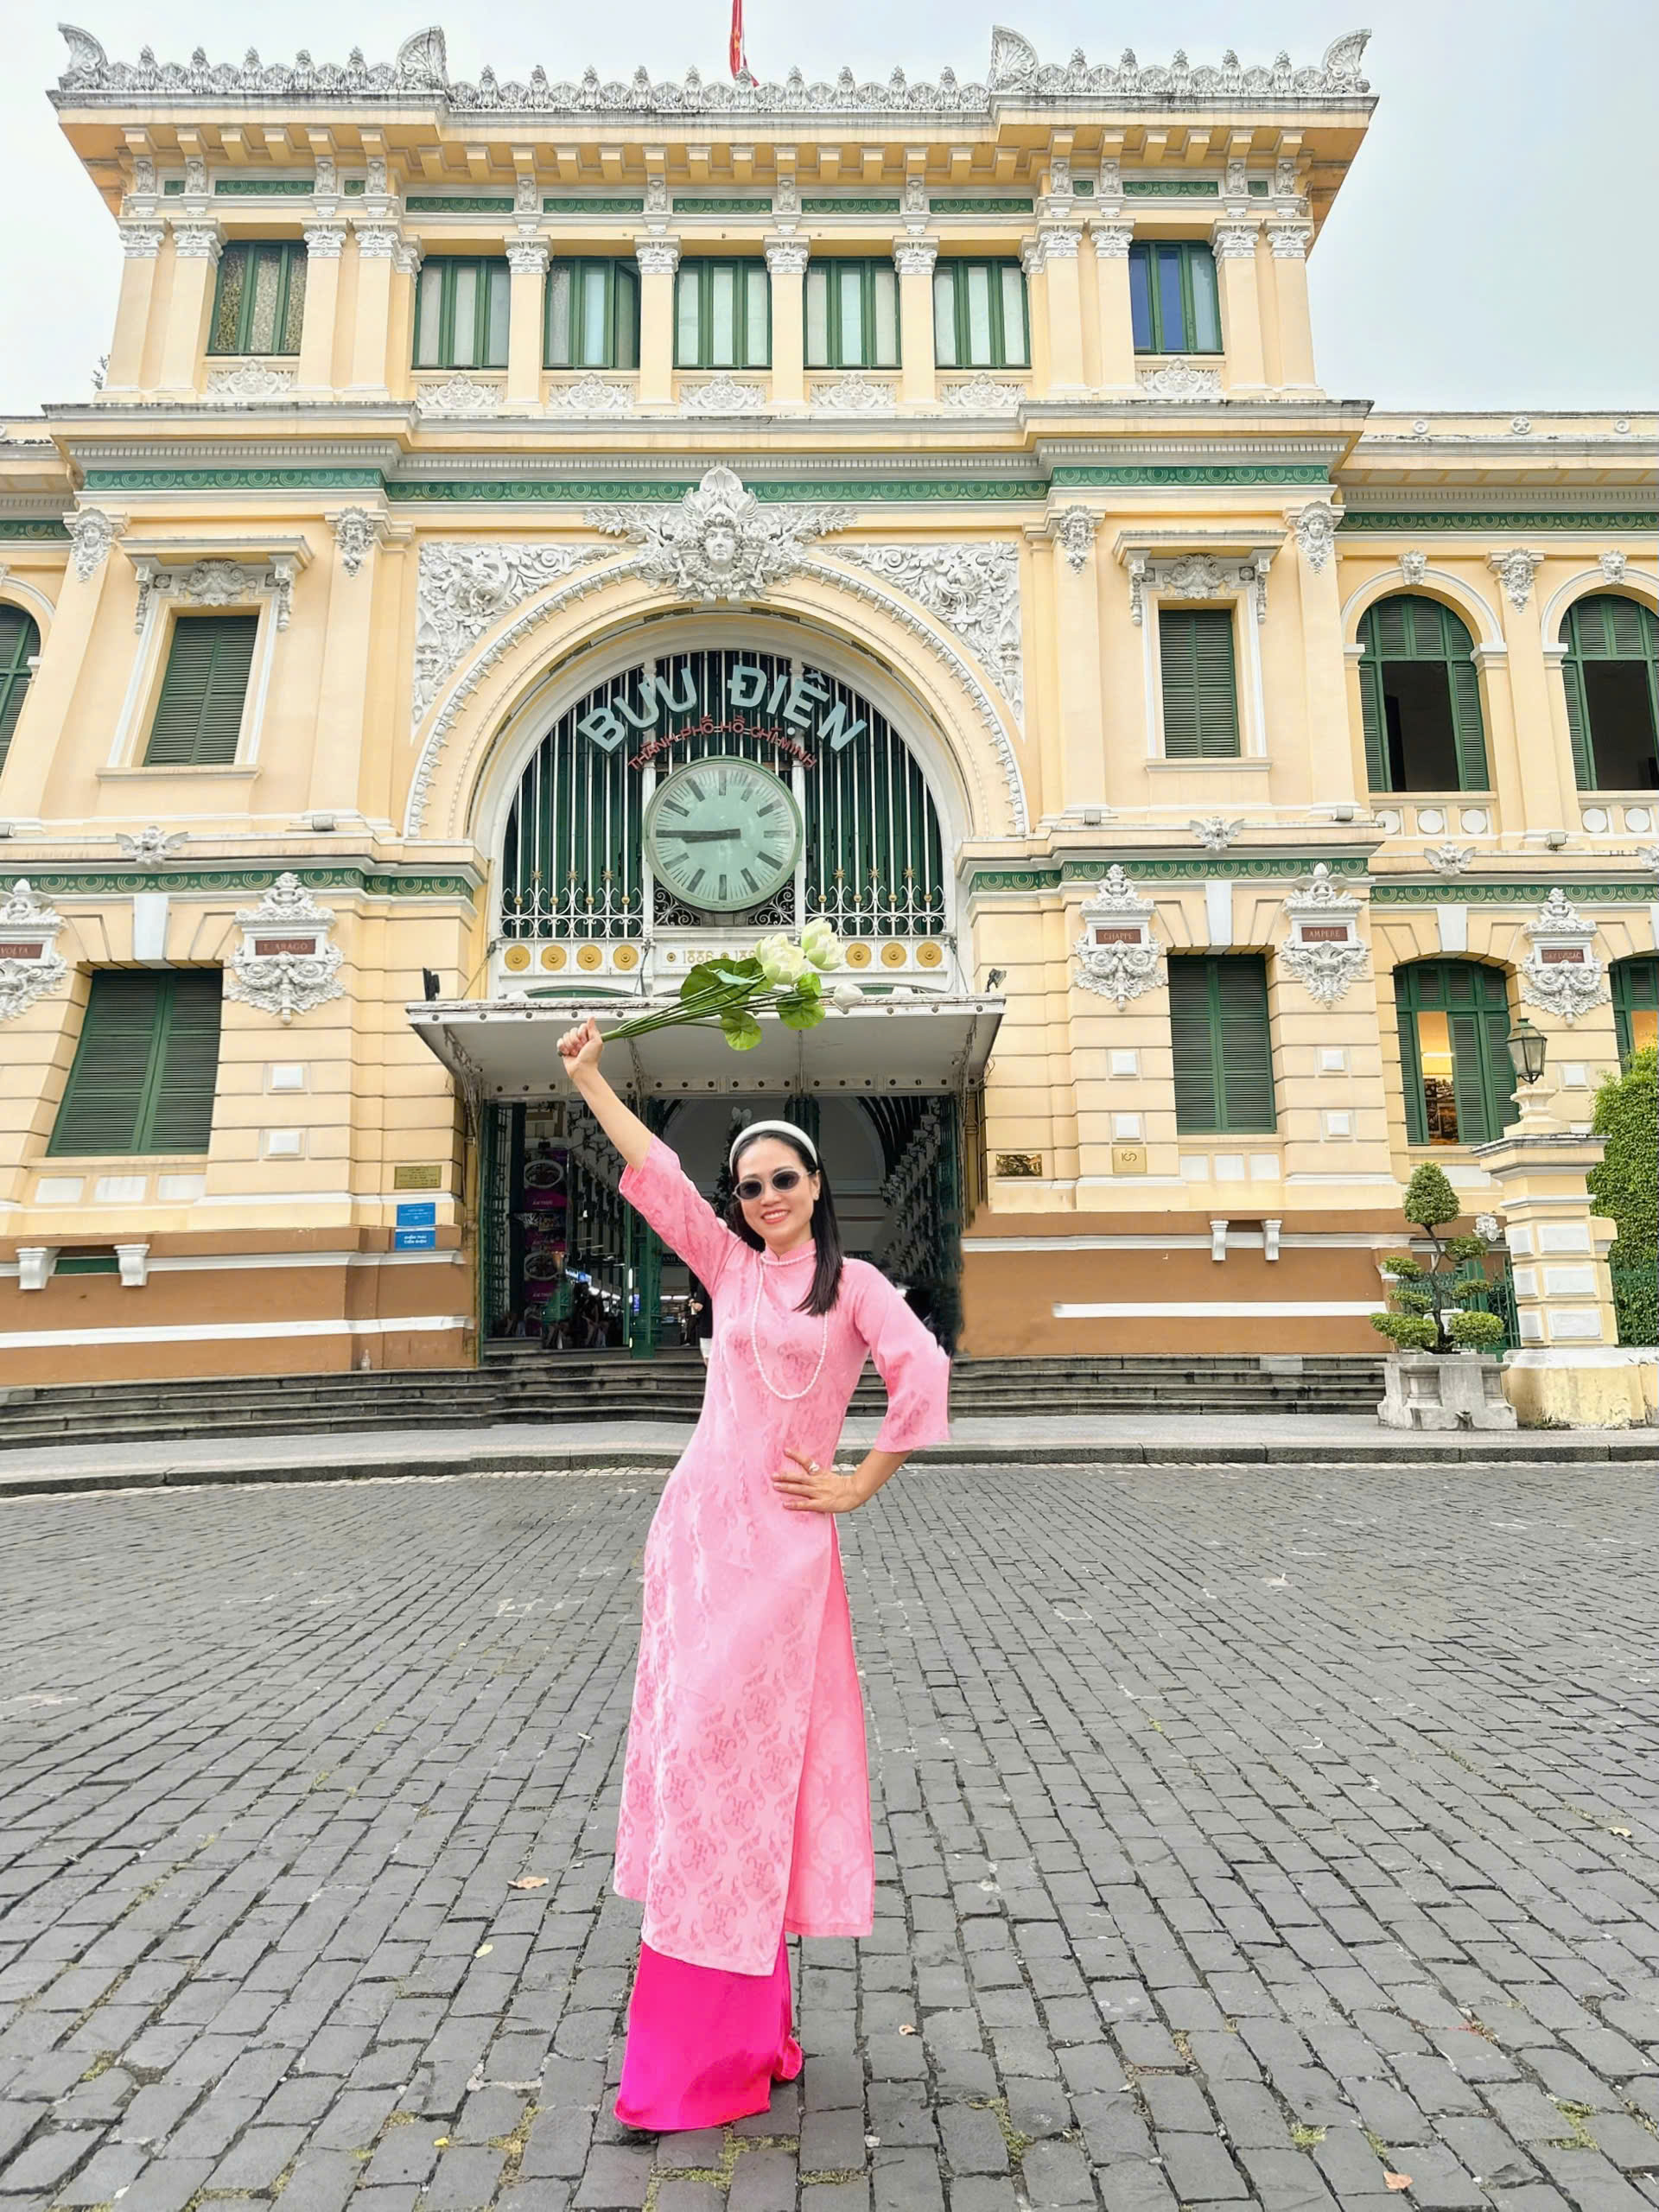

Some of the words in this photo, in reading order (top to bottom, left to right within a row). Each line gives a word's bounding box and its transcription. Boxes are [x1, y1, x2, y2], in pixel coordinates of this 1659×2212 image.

[577, 665, 697, 753] BƯU
[727, 664, 868, 752] ĐIỆN
[628, 734, 678, 771] THÀNH
[680, 714, 715, 741] PHỐ
[721, 715, 746, 733] HỒ
[779, 737, 817, 768] MINH
